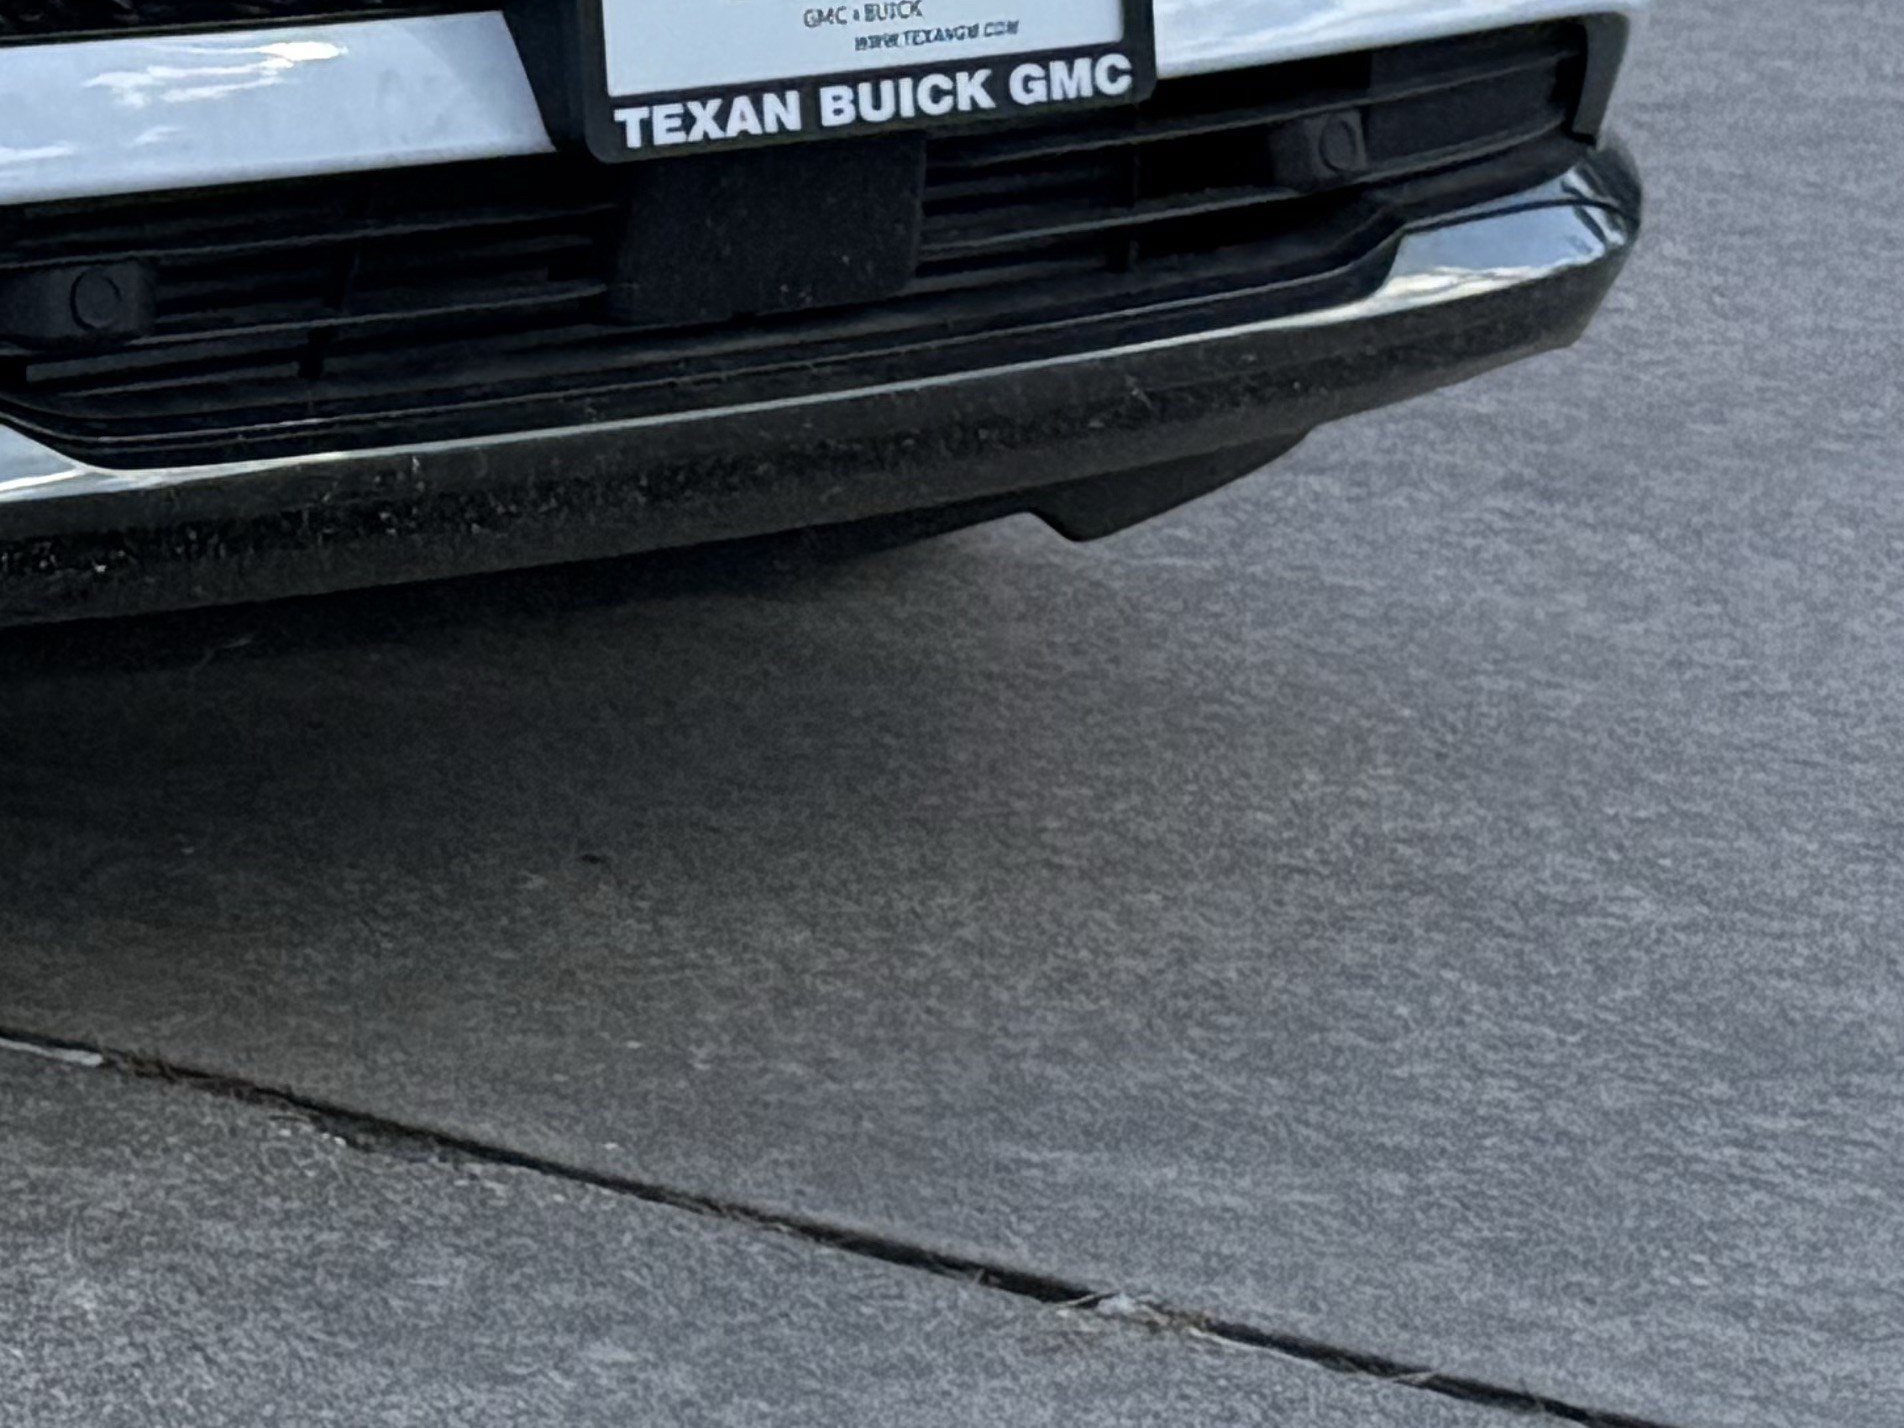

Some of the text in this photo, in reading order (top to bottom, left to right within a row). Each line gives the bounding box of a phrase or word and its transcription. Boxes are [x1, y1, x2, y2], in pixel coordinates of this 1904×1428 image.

[803, 5, 848, 28] GMC
[614, 53, 1134, 149] TEXAN BUICK GMC
